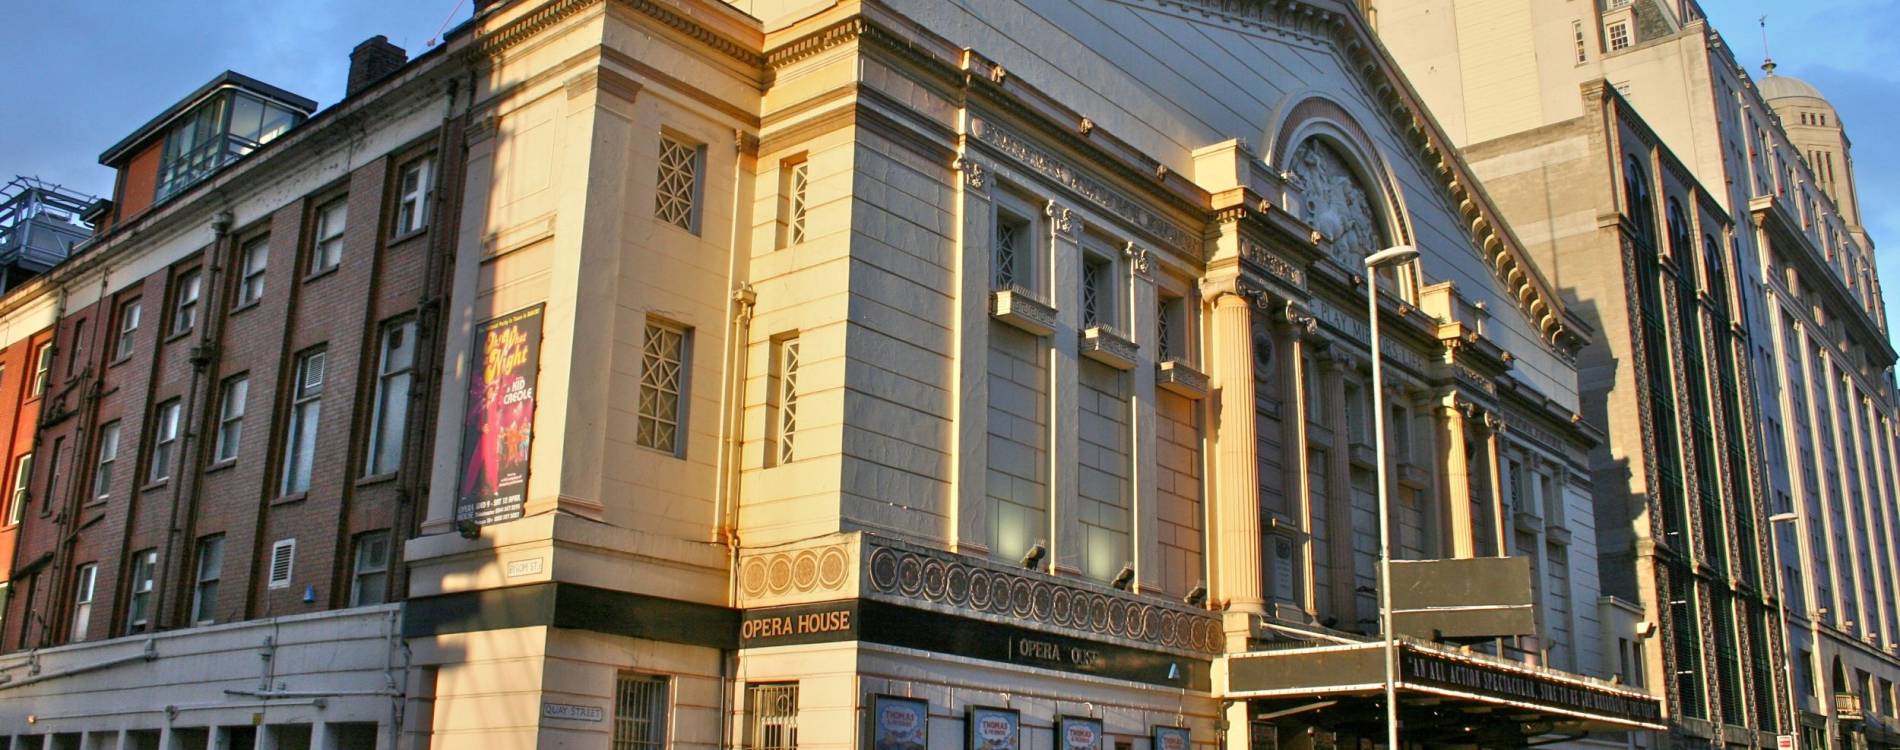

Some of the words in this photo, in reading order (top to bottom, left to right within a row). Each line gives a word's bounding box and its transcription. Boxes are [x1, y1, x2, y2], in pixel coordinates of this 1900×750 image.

[1320, 302, 1347, 332] PLAY
[484, 344, 528, 384] Night
[503, 387, 533, 405] CREOLE
[743, 616, 793, 639] OPERA
[797, 610, 850, 635] HOUSE
[1019, 637, 1061, 662] OPERA
[1429, 660, 1447, 682] ALL
[1450, 664, 1480, 688] ACTION
[545, 704, 571, 716] QUAY
[571, 705, 601, 719] STREET
[982, 720, 1008, 730] THOMAS
[1070, 728, 1092, 738] THOMAS
